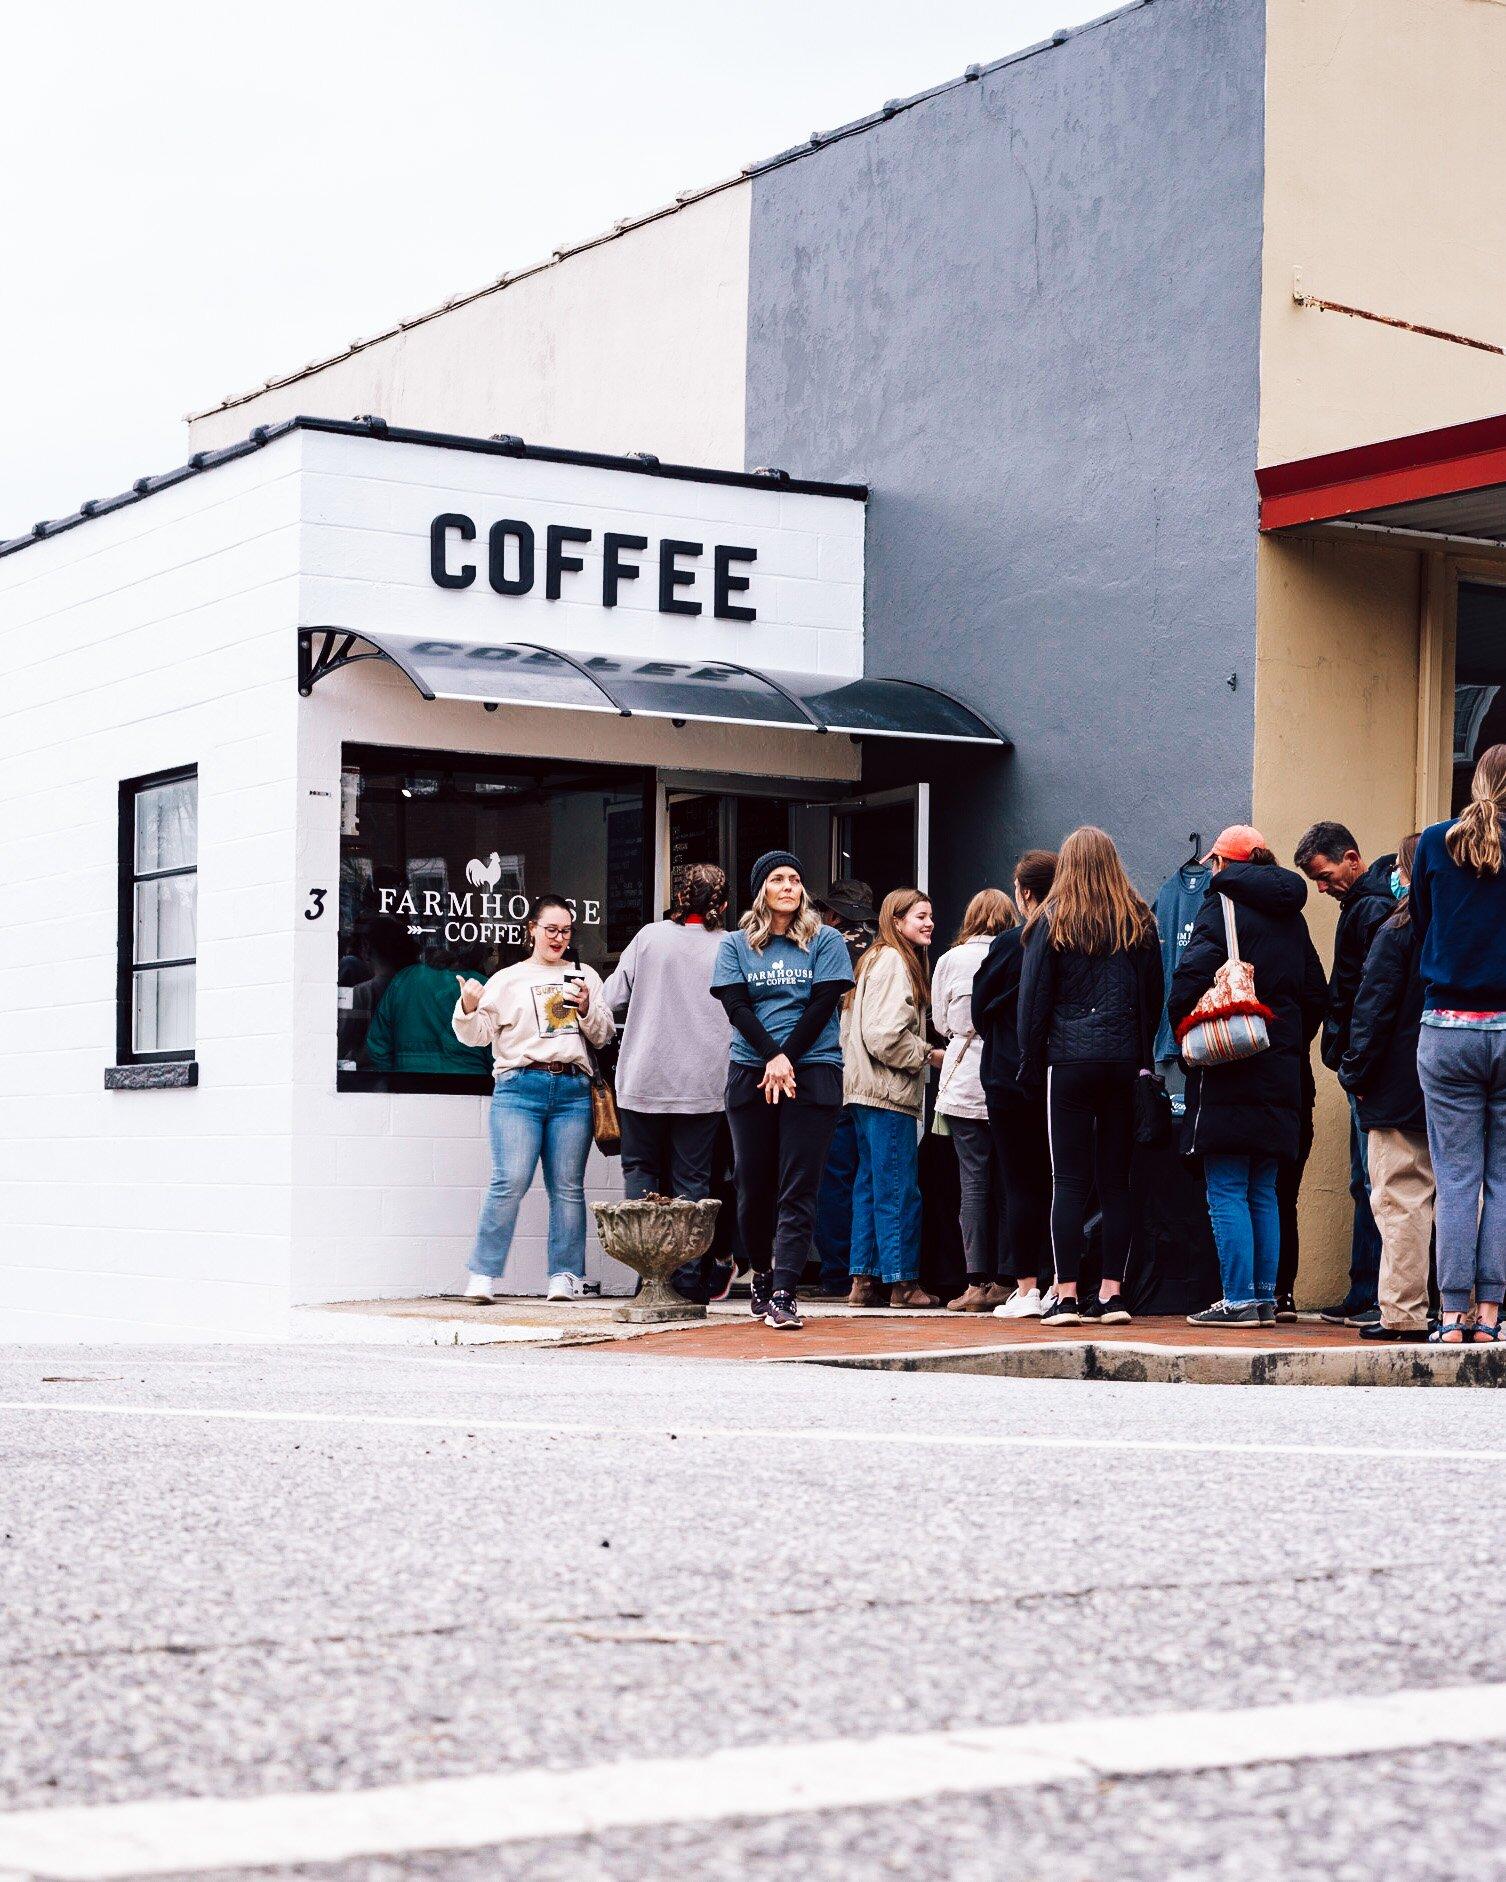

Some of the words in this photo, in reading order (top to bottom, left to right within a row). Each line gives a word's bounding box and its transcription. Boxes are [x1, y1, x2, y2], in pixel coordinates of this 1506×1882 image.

[430, 512, 757, 622] COFFEE
[304, 888, 327, 920] 3
[378, 888, 602, 924] FARMHOSE
[444, 922, 527, 945] COFFE
[747, 968, 814, 982] FARMHOUSE
[766, 977, 797, 986] COFFEE
